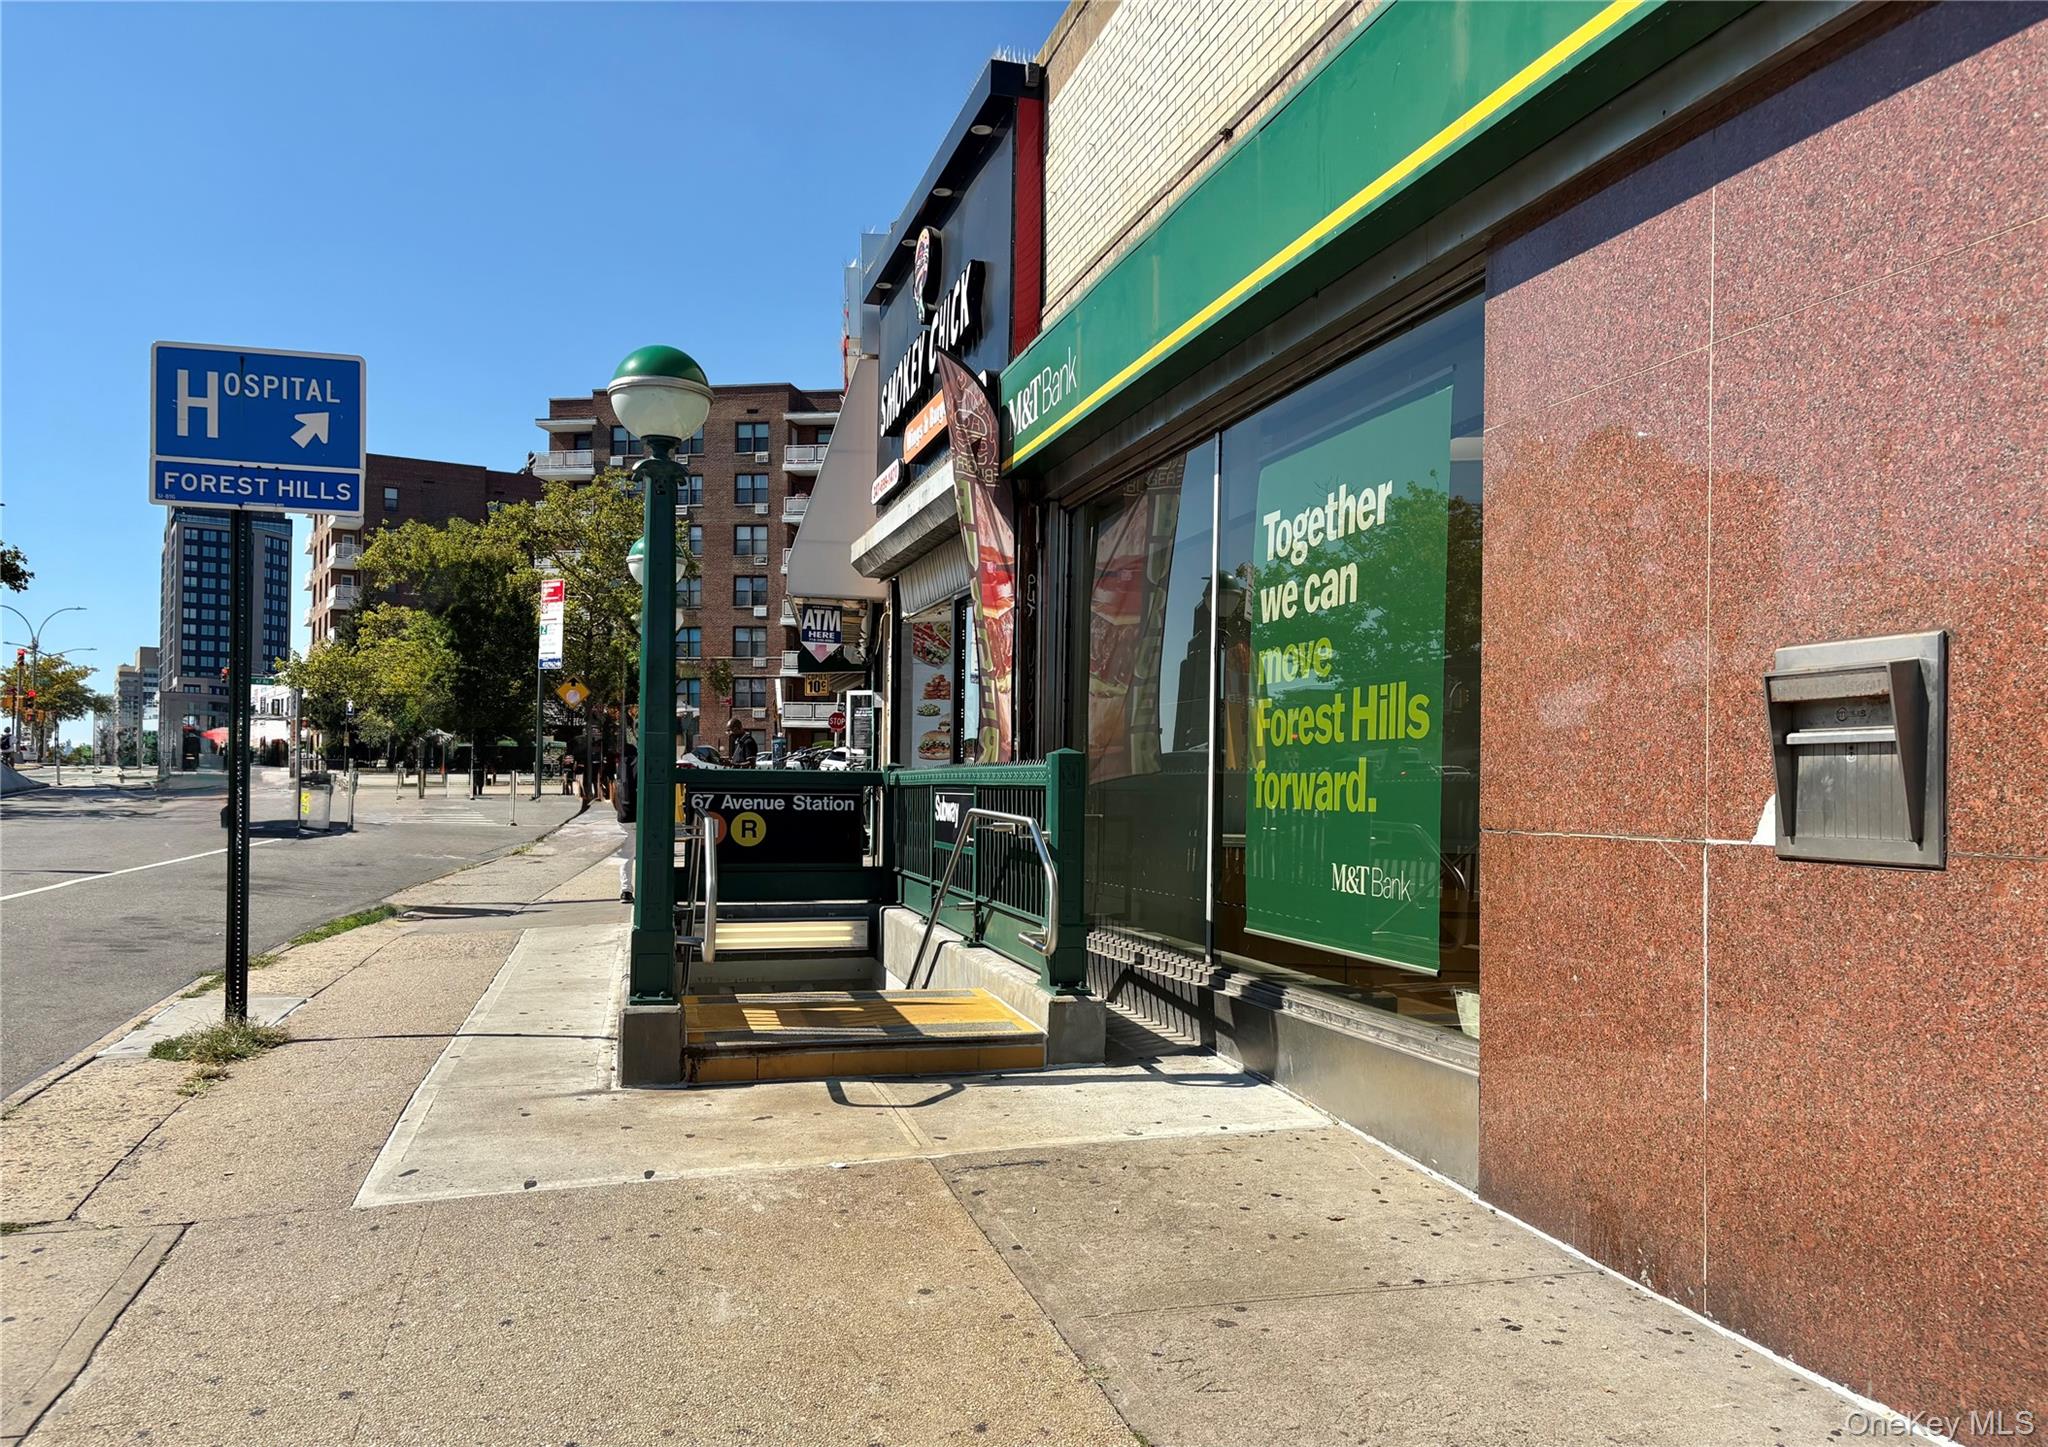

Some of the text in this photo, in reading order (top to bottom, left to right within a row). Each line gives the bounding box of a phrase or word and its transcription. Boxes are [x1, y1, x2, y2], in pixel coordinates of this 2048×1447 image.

[881, 331, 926, 437] SMOKEY
[929, 262, 970, 375] CHICK
[1008, 346, 1077, 440] M&T Bank
[164, 471, 352, 501] FOREST HILLS
[1263, 480, 1393, 566] Together
[1260, 562, 1358, 624] we can
[803, 608, 841, 632] ATM
[808, 630, 835, 640] HERE
[1257, 637, 1333, 685] move
[829, 717, 845, 726] STOP
[1256, 681, 1431, 747] Forest Hills
[691, 793, 855, 812] 67 Avenue Station
[1254, 757, 1377, 813] forward.
[741, 819, 758, 839] R
[935, 794, 960, 829] Subway
[1331, 863, 1411, 902] M&T Bank
